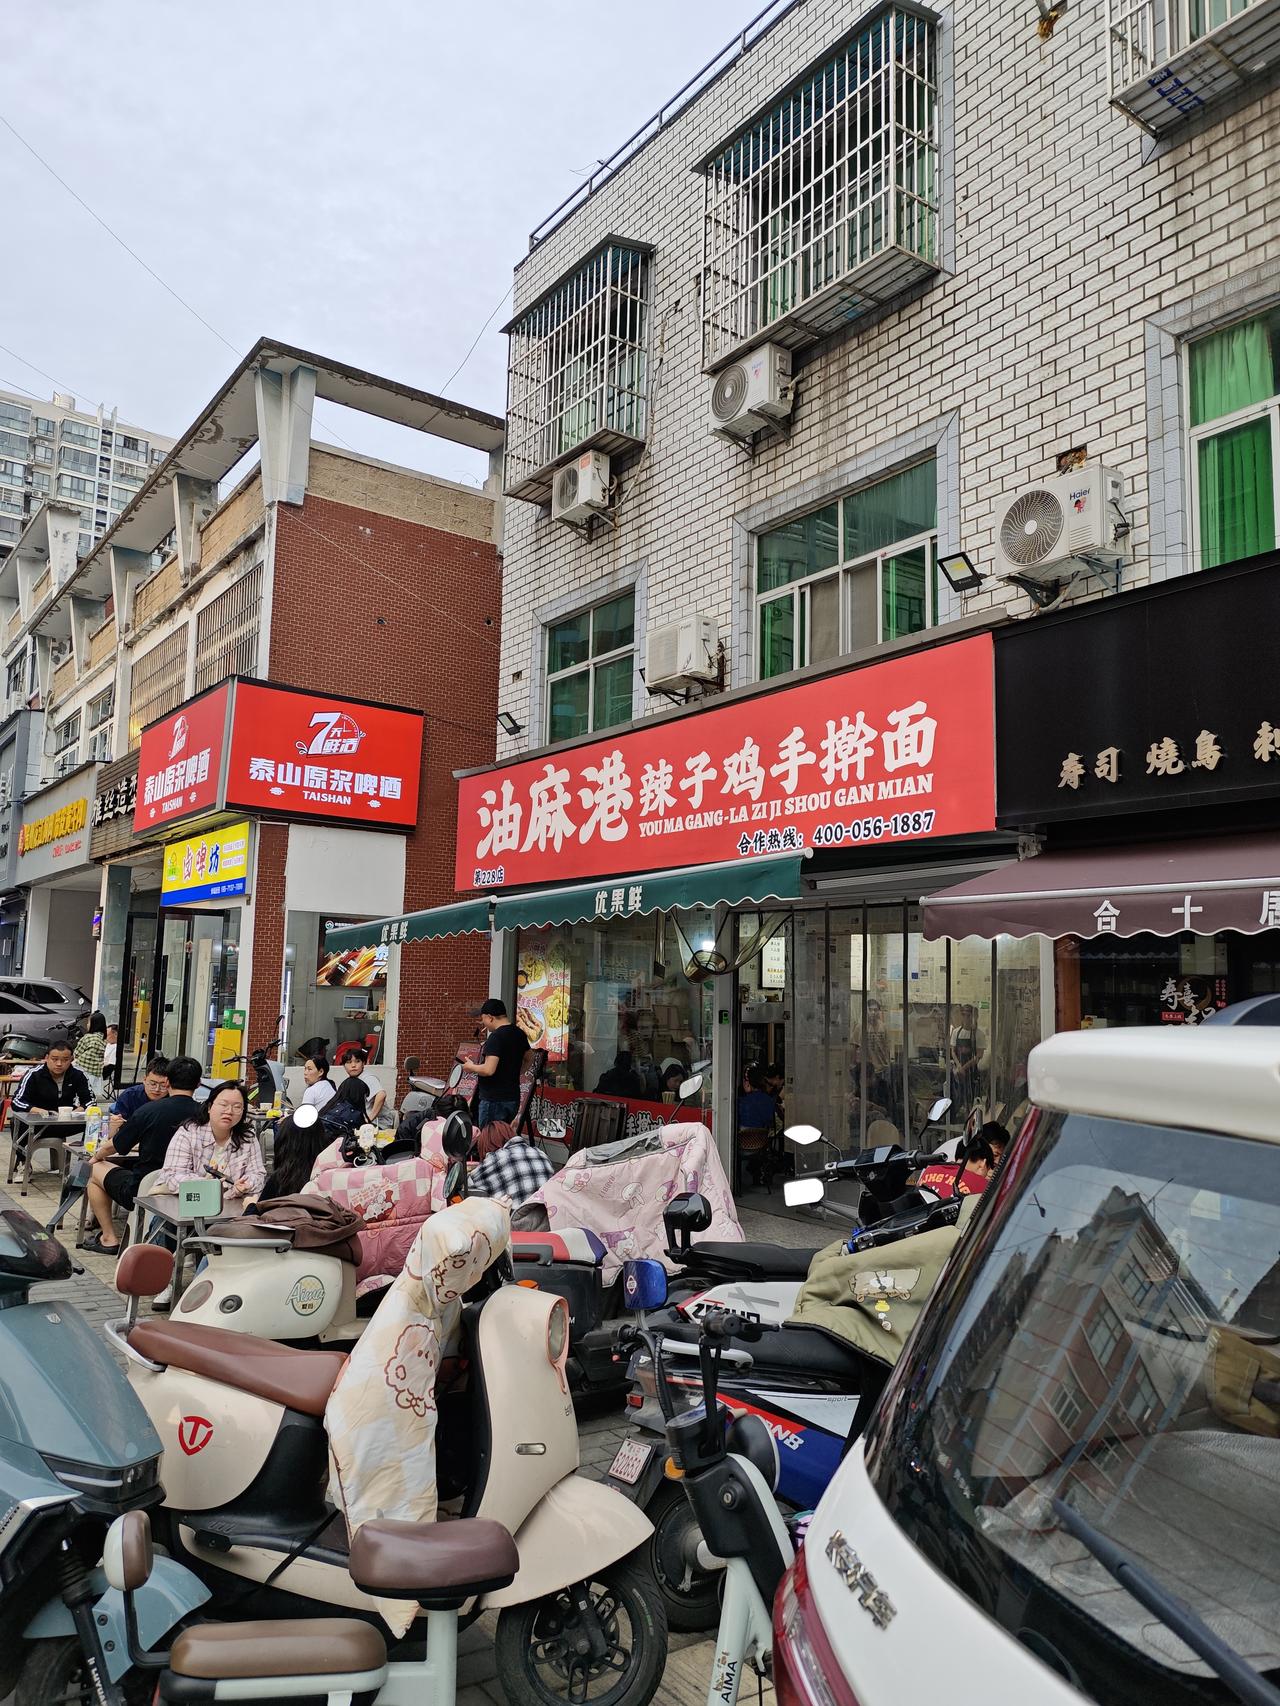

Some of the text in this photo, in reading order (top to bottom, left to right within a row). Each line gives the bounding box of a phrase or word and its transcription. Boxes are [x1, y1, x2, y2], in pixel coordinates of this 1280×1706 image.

[1070, 488, 1091, 501] Haier
[144, 748, 211, 806] 泰山原浆啤酒
[249, 757, 403, 800] 泰山原浆啤酒
[1057, 746, 1122, 790] 寿司
[161, 796, 184, 814] TAISHAN
[303, 790, 352, 805] TAISHAN
[639, 821, 663, 837] YOU
[664, 818, 684, 833] MA
[751, 801, 769, 820] ZI
[769, 800, 782, 822] JI
[784, 790, 832, 815] SHOU
[834, 783, 875, 807] GAN
[876, 773, 935, 801] MIAN
[813, 810, 935, 845] 400-056-1887
[474, 866, 505, 886] 第228店
[595, 886, 643, 914] 优果鲜
[381, 921, 409, 942] 优果鲜
[185, 1192, 201, 1202] 爱玛
[285, 1281, 326, 1306] Aima
[721, 1661, 738, 1704] AIMA
